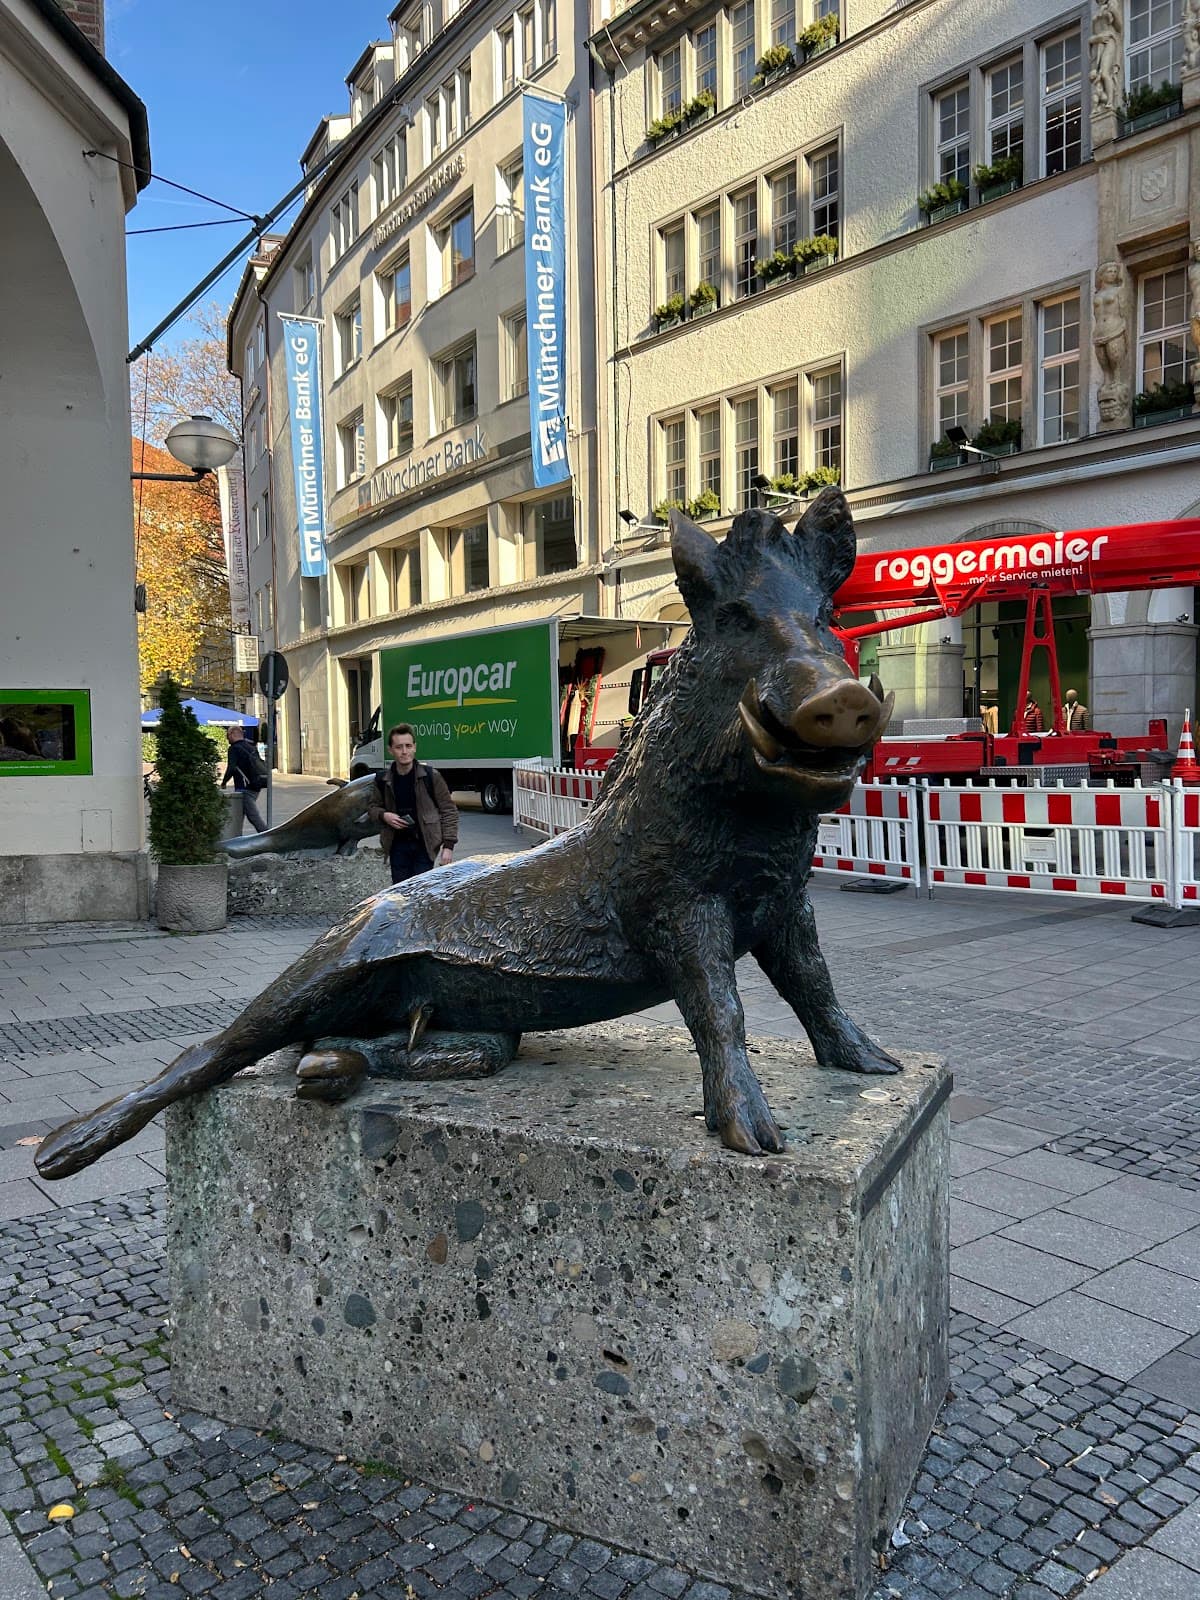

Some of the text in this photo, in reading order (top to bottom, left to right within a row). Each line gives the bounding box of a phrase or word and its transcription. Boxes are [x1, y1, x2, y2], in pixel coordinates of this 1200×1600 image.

[530, 122, 559, 411] Münchner Bank eG
[291, 337, 320, 525] Münchner Bank eG
[370, 424, 488, 507] Münchner Bank
[874, 531, 1109, 587] roggermaier
[999, 570, 1039, 583] Service
[1040, 564, 1084, 579] mieten!
[407, 661, 517, 707] Europcar
[453, 721, 487, 741] your
[487, 718, 518, 738] way
